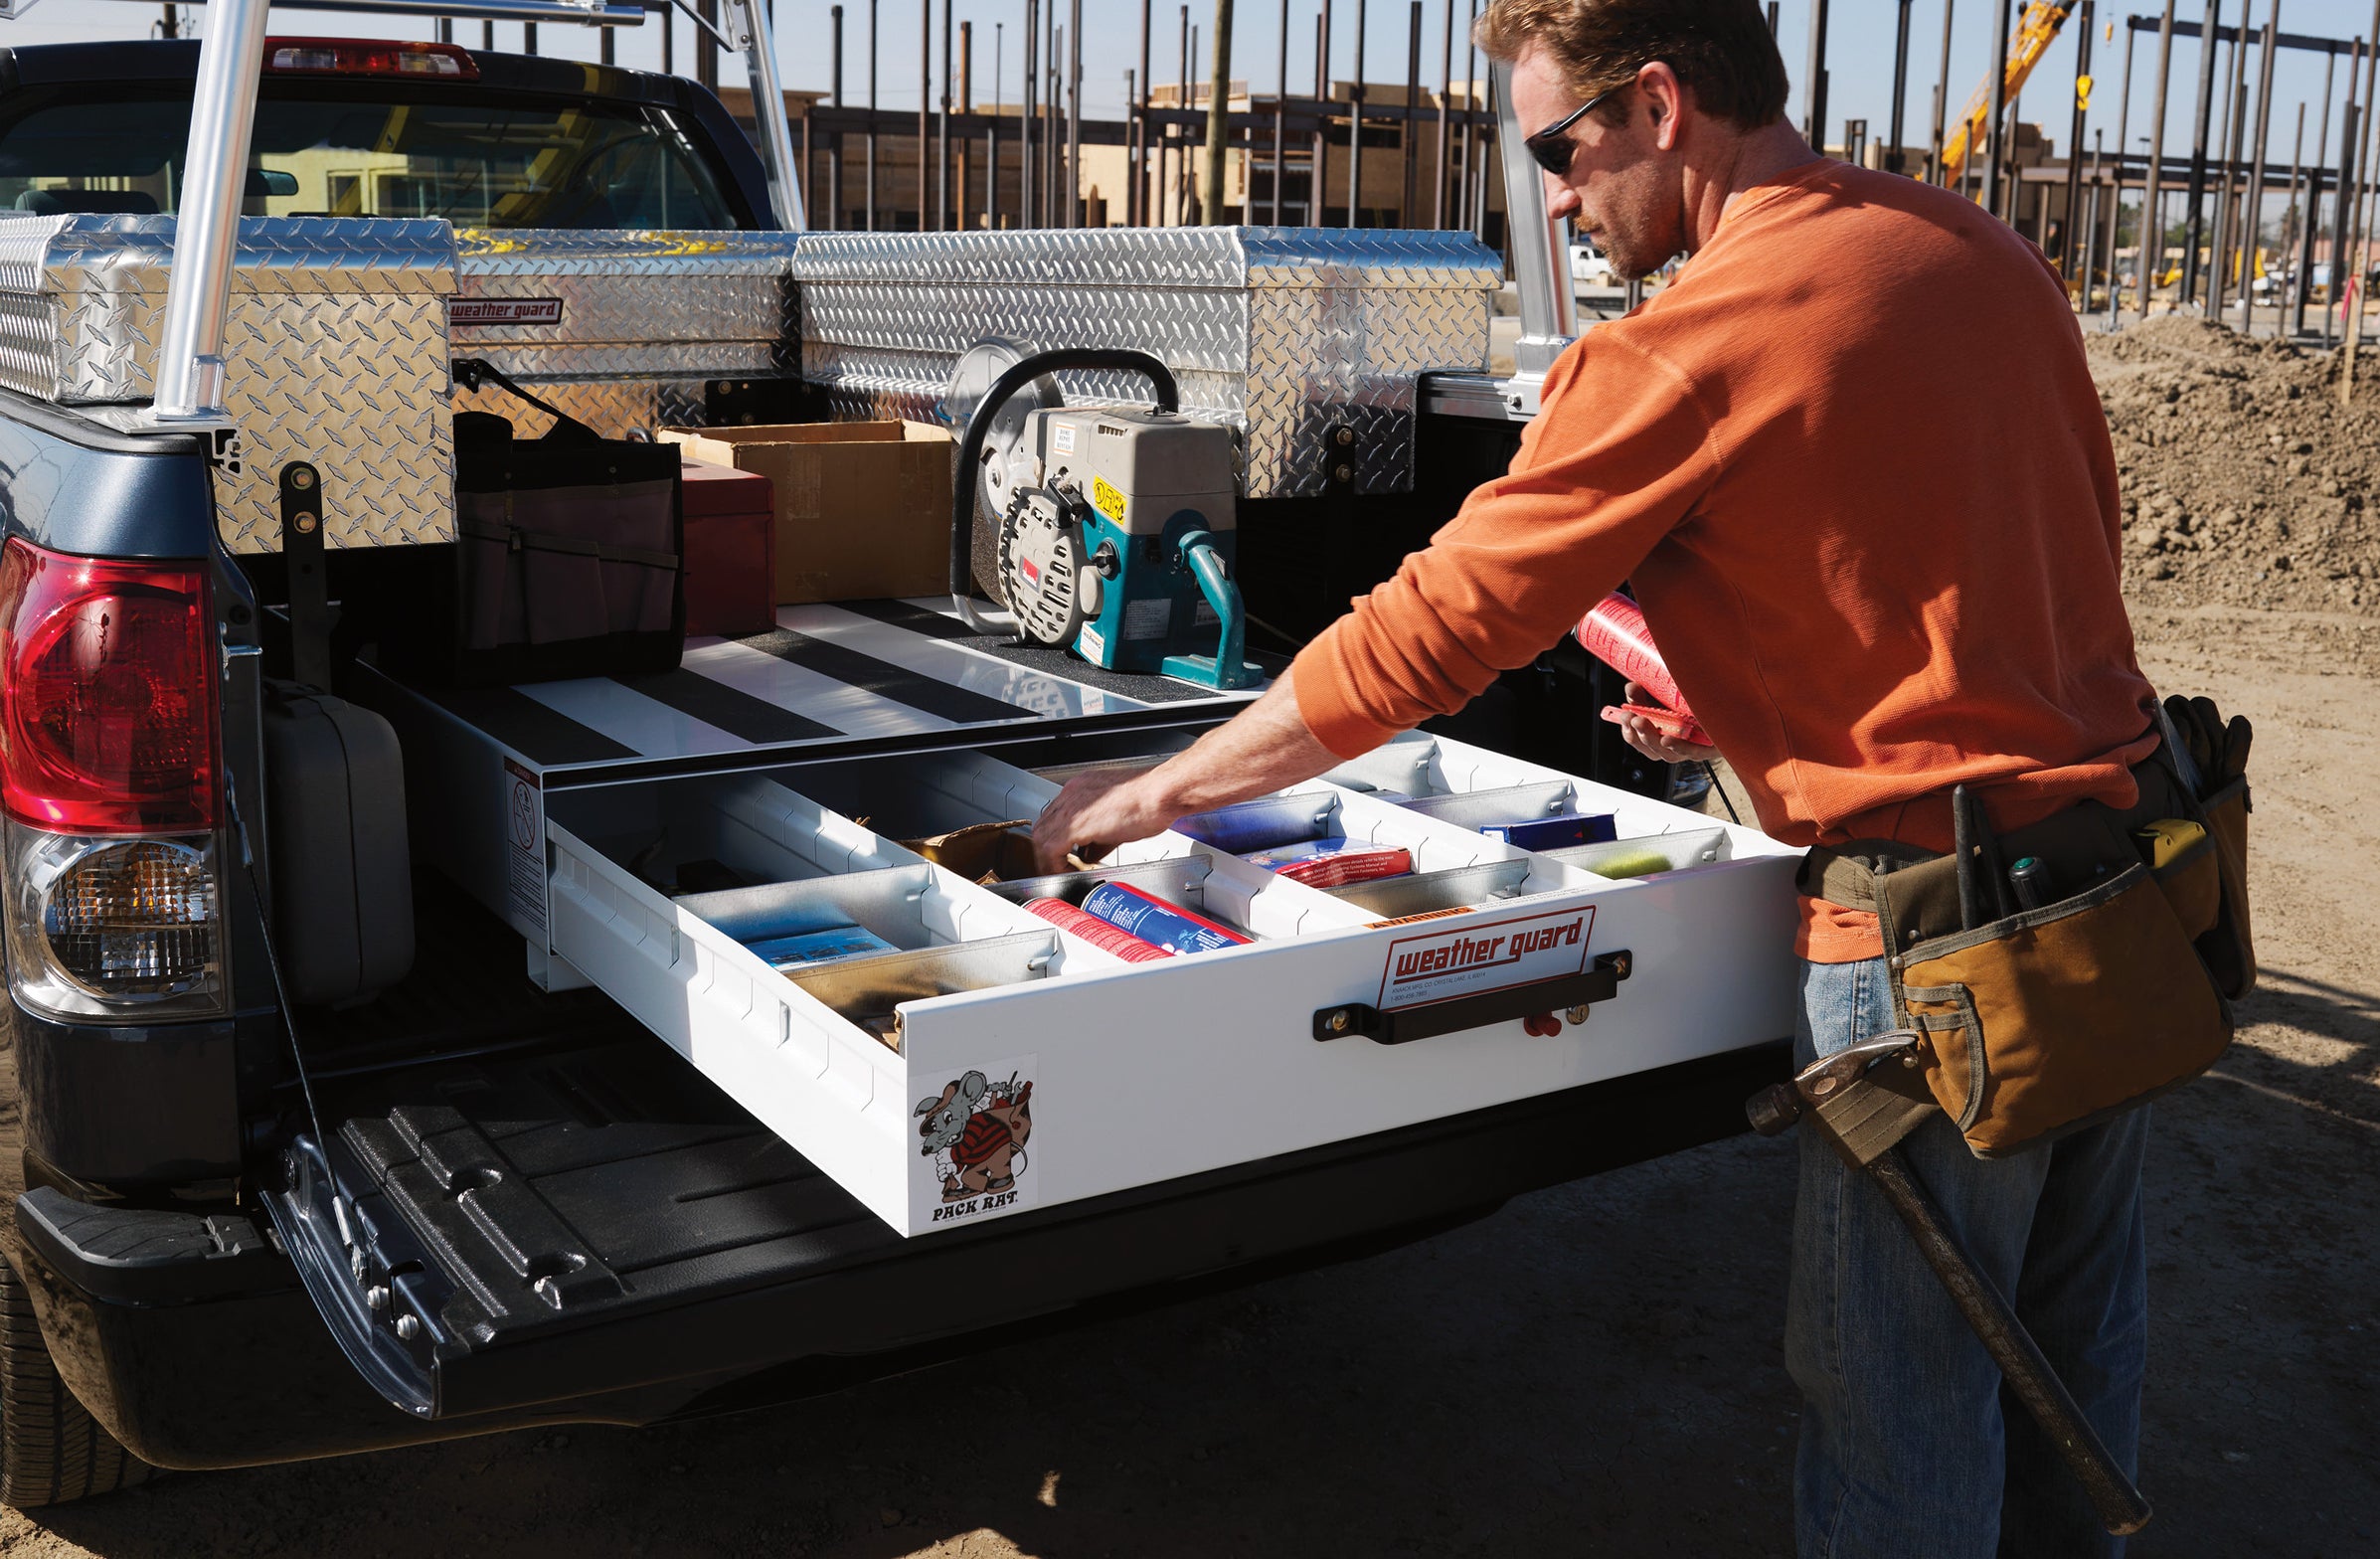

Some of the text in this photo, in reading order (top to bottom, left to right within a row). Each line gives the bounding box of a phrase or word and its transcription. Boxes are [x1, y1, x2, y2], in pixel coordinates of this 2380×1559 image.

[450, 302, 556, 319] weather guard
[1395, 917, 1583, 977] weather guard
[933, 1199, 978, 1222] PACK
[982, 1190, 1018, 1210] RAT
